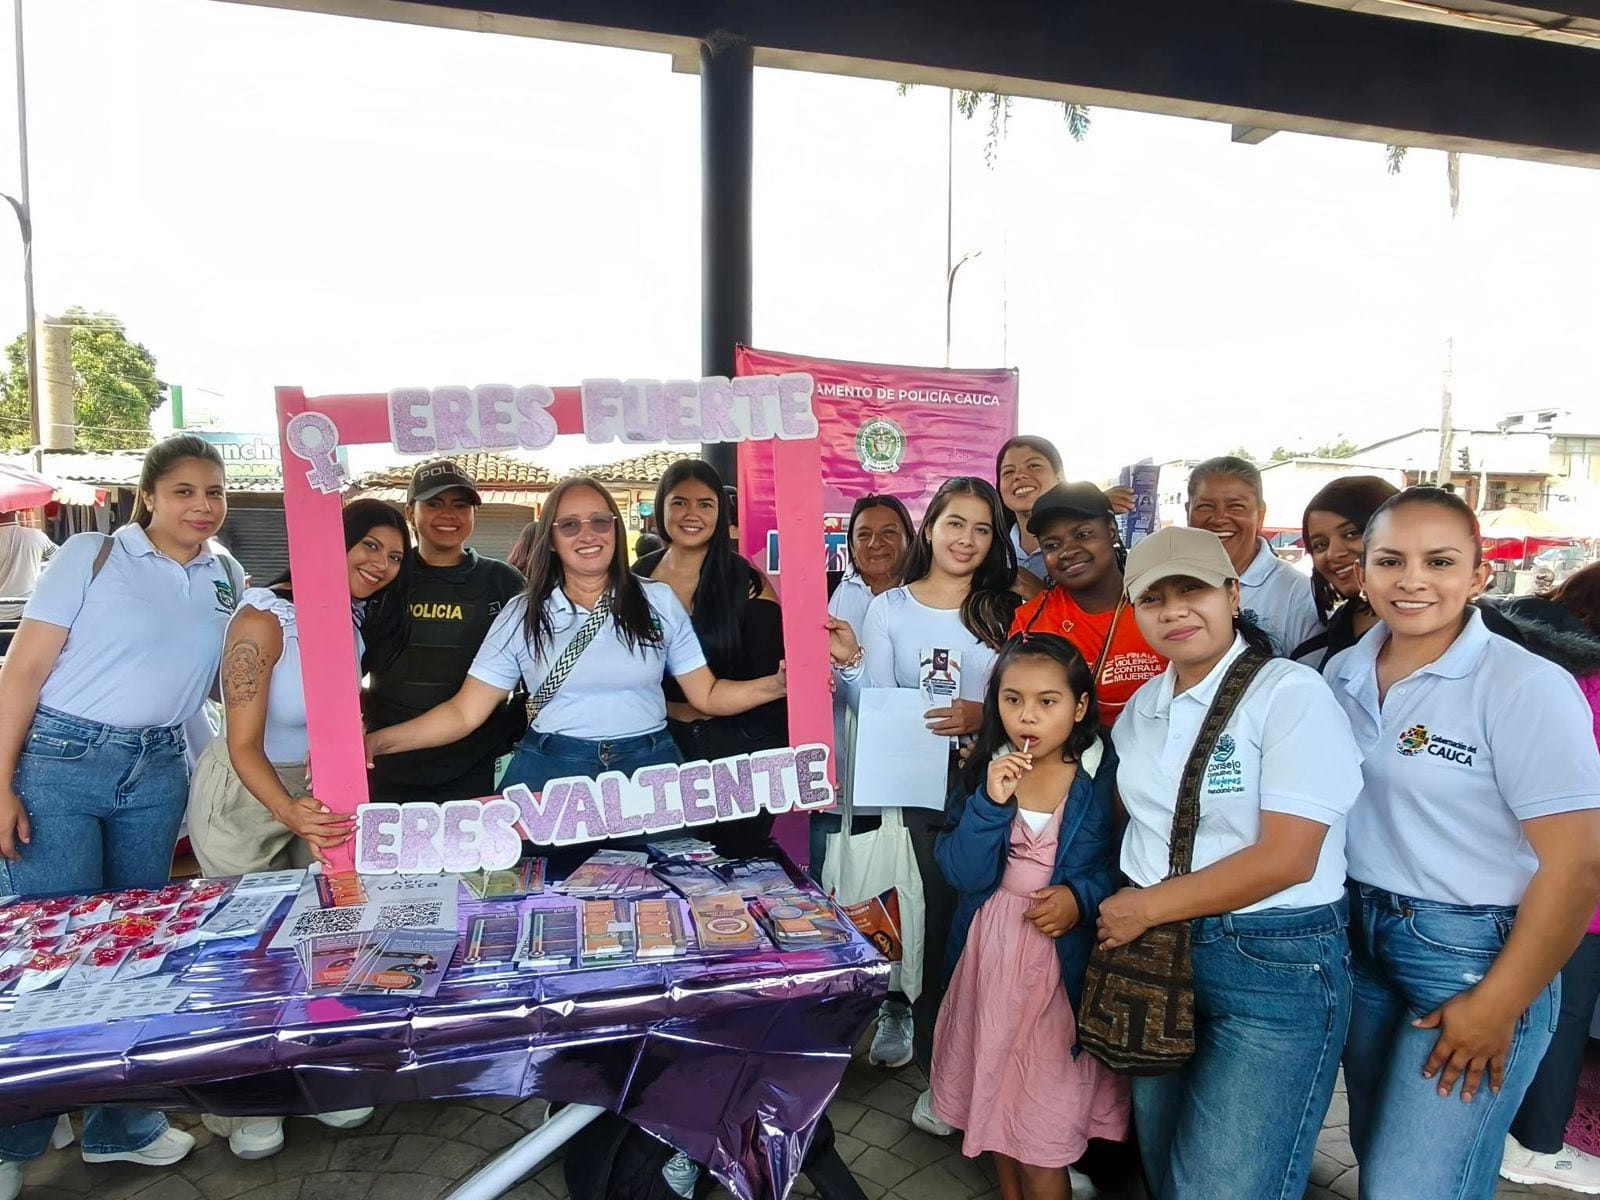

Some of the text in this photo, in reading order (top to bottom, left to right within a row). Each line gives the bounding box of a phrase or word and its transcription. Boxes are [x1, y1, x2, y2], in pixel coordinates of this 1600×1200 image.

[817, 384, 1000, 406] AMENTO DE POLICÍA CAUCA
[391, 386, 556, 453] ERES
[583, 374, 817, 443] FUERTE
[1114, 664, 1151, 675] CONTRA
[1208, 760, 1241, 773] Consejo
[1427, 744, 1473, 767] CAUCA
[357, 746, 829, 873] ERES VALIENTE
